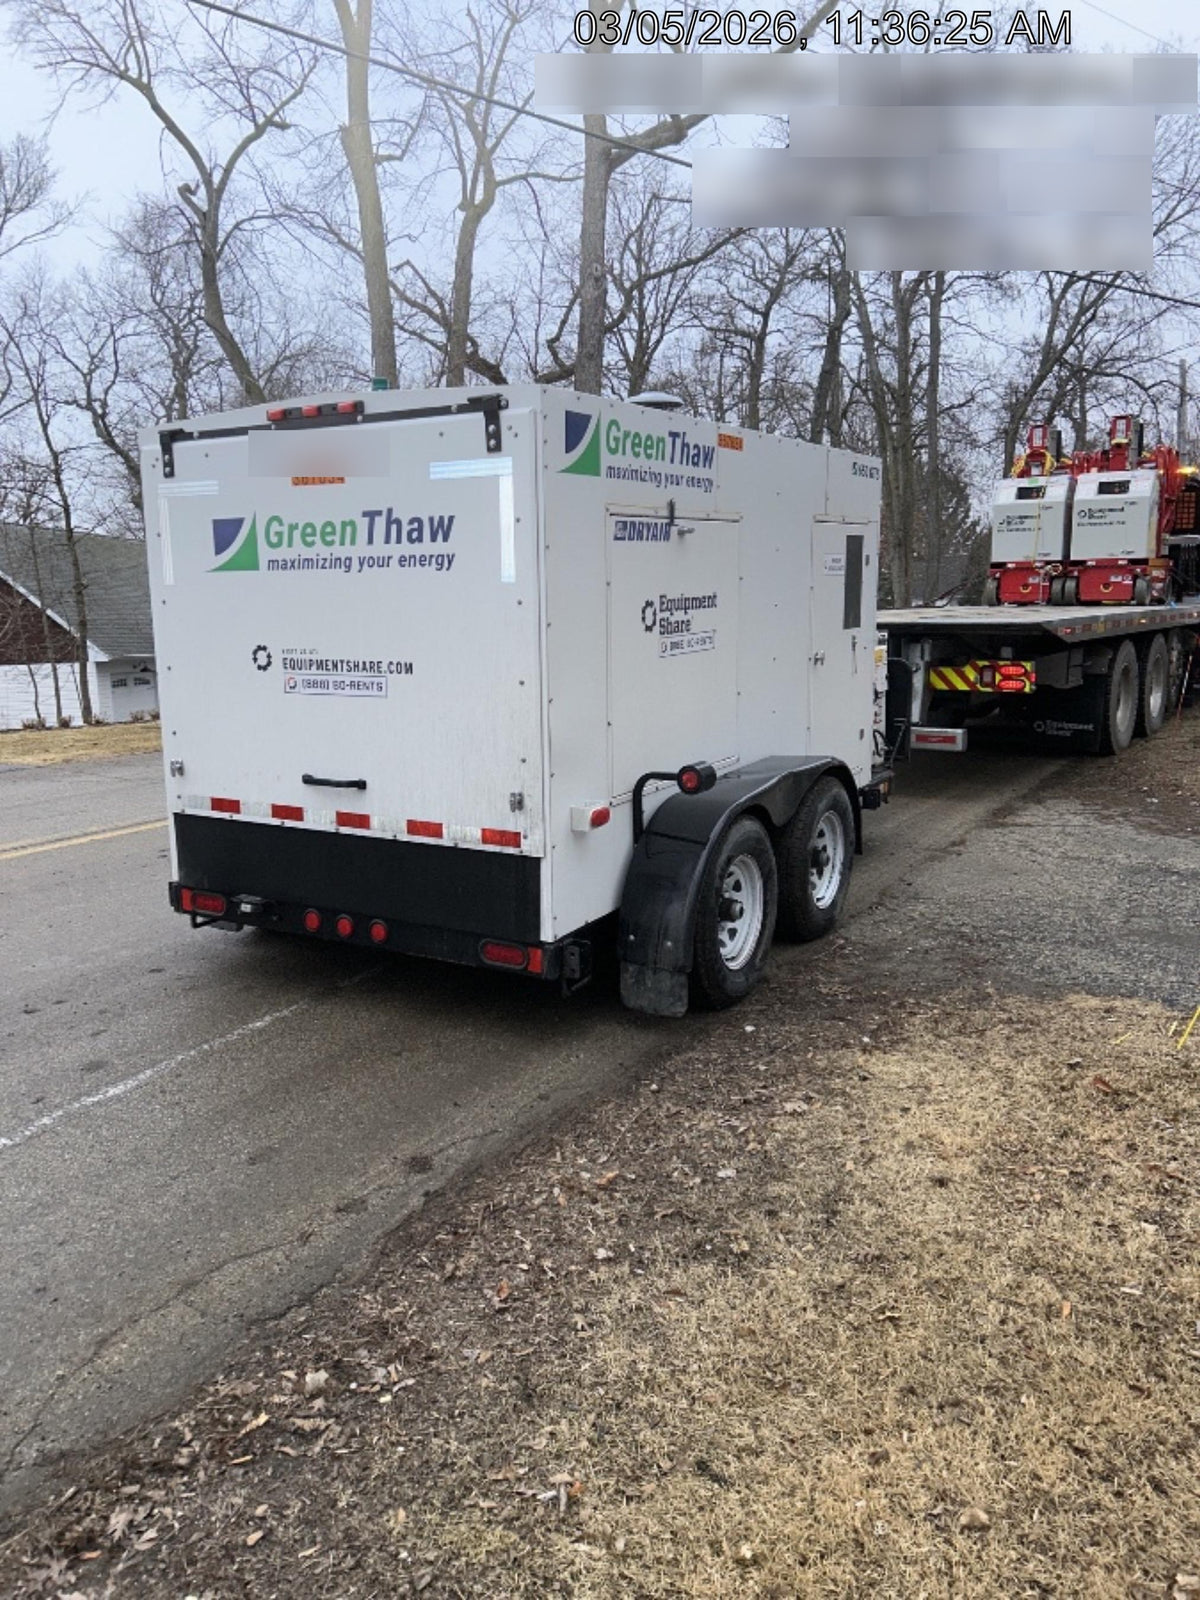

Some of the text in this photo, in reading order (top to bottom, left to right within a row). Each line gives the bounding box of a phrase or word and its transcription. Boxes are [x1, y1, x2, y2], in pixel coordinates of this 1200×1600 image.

[606, 464, 714, 493] maximizing your energy
[627, 521, 671, 542] DRYAIR
[267, 552, 456, 573] maximizing your energy
[659, 592, 718, 615] Equipment
[659, 617, 691, 635] Share
[282, 657, 414, 675] EQUIPMENTSHARE.COM
